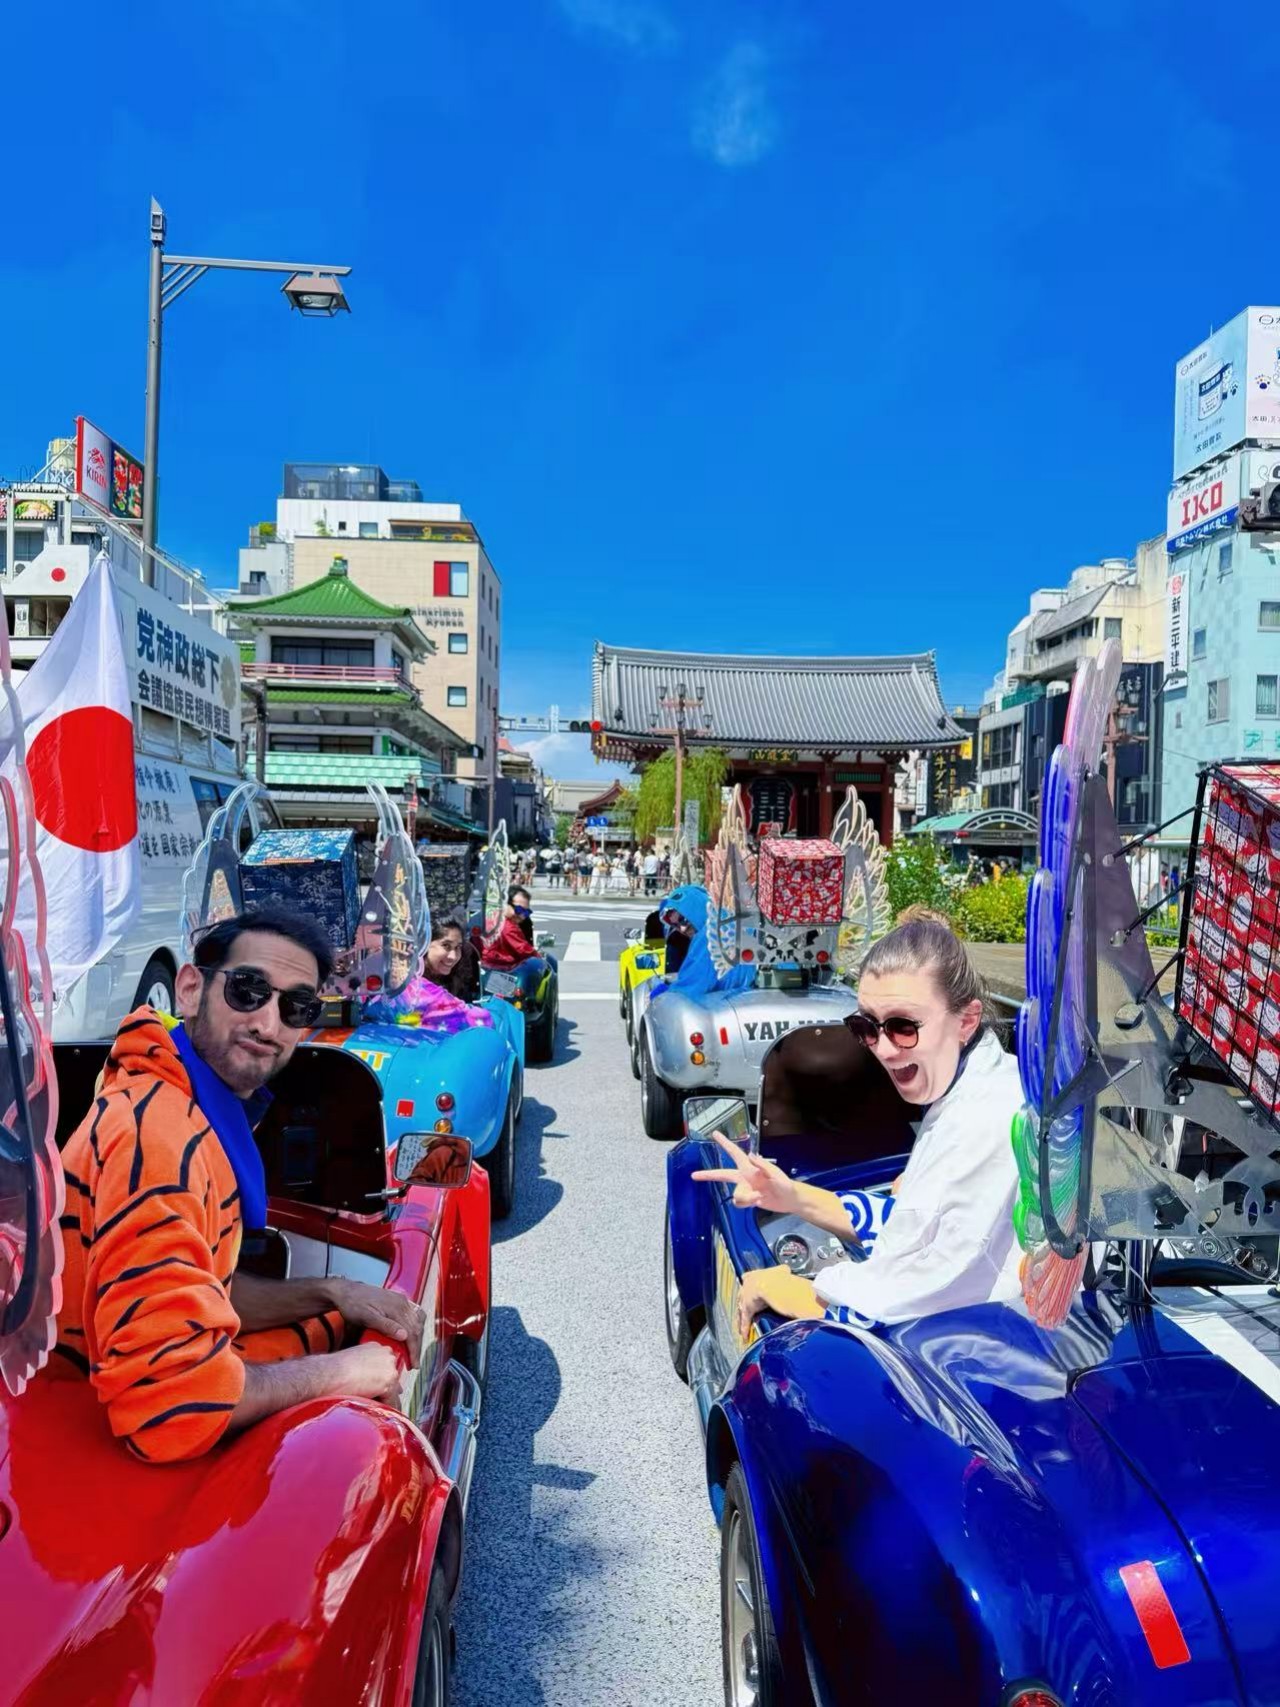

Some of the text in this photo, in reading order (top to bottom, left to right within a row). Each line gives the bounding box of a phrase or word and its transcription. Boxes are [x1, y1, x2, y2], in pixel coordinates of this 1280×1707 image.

[86, 464, 107, 490] KIRIN
[1181, 480, 1223, 527] IKO
[744, 1020, 790, 1041] YAH
